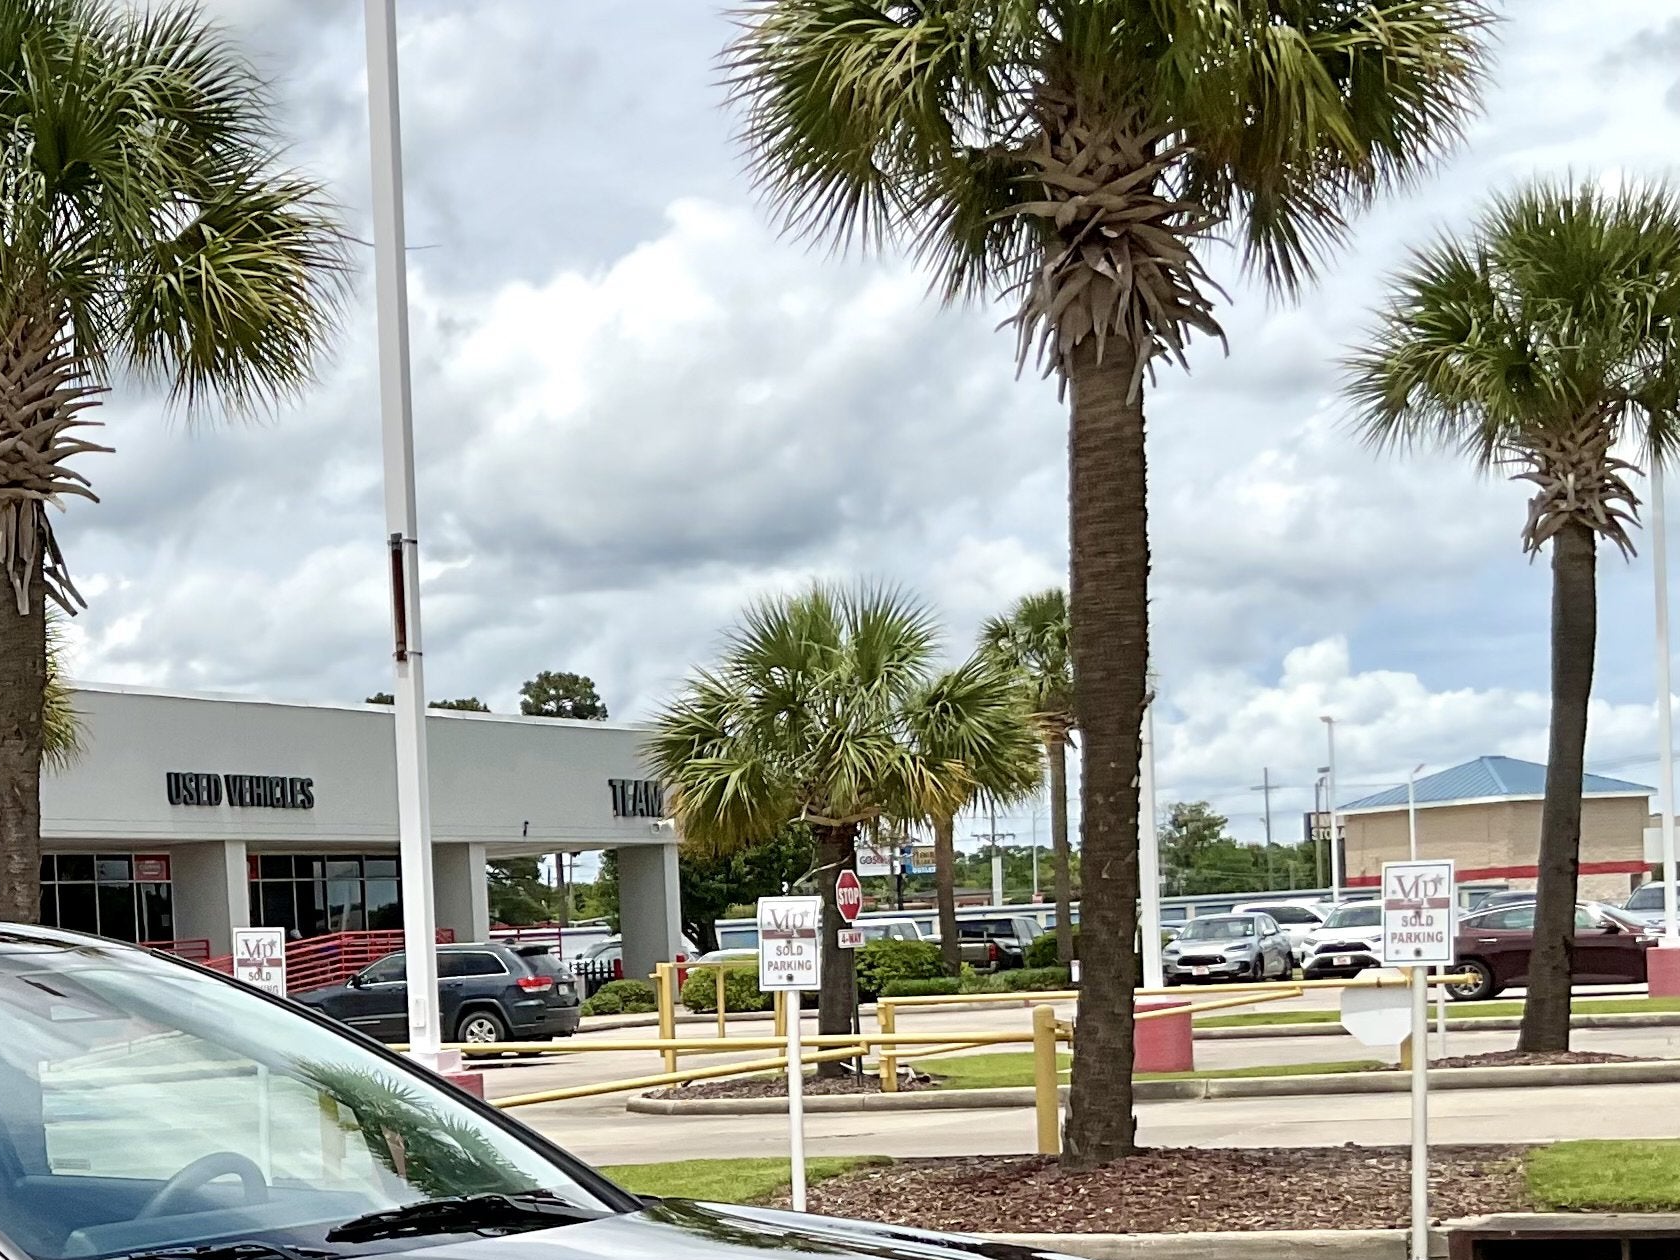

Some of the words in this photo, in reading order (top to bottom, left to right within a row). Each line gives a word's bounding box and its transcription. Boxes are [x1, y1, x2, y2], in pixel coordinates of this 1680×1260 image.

[166, 772, 222, 806] USED
[224, 774, 314, 809] VEHICLES
[839, 887, 859, 905] STOP
[1401, 915, 1434, 927] SOLD
[841, 933, 861, 944] 4-WAY
[1390, 931, 1444, 944] PARKING
[776, 945, 803, 957] SOLD
[767, 959, 812, 971] PARKING
[248, 971, 272, 981] SOLD
